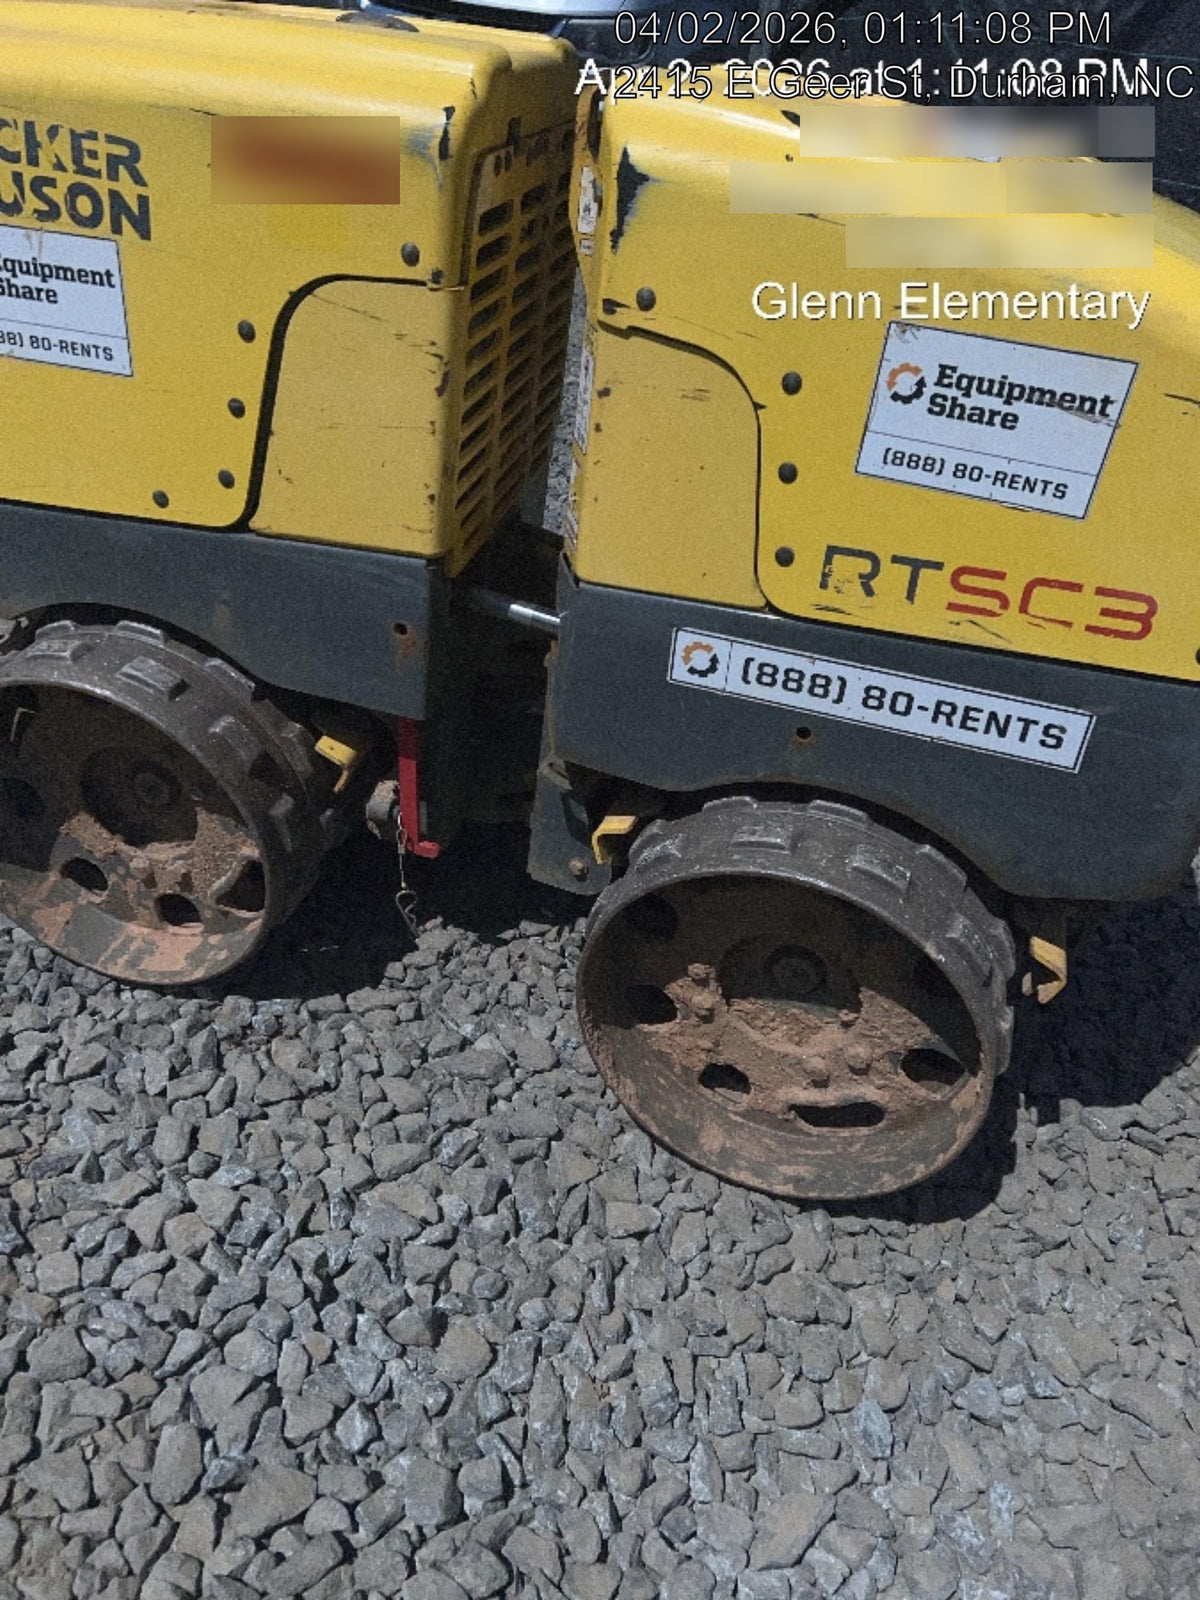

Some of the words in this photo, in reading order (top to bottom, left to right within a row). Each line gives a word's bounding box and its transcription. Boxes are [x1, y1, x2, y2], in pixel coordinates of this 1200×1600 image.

[0, 252, 116, 289] quipment
[29, 334, 114, 362] 80-RENTS
[927, 392, 1020, 431] Share
[933, 363, 1118, 418] Equipment
[882, 447, 945, 476] (888)
[952, 462, 1069, 500] 80-RENTS
[818, 544, 1158, 641] RTSC3
[741, 657, 848, 705] (888)
[861, 684, 1068, 751] 80-RENTS
